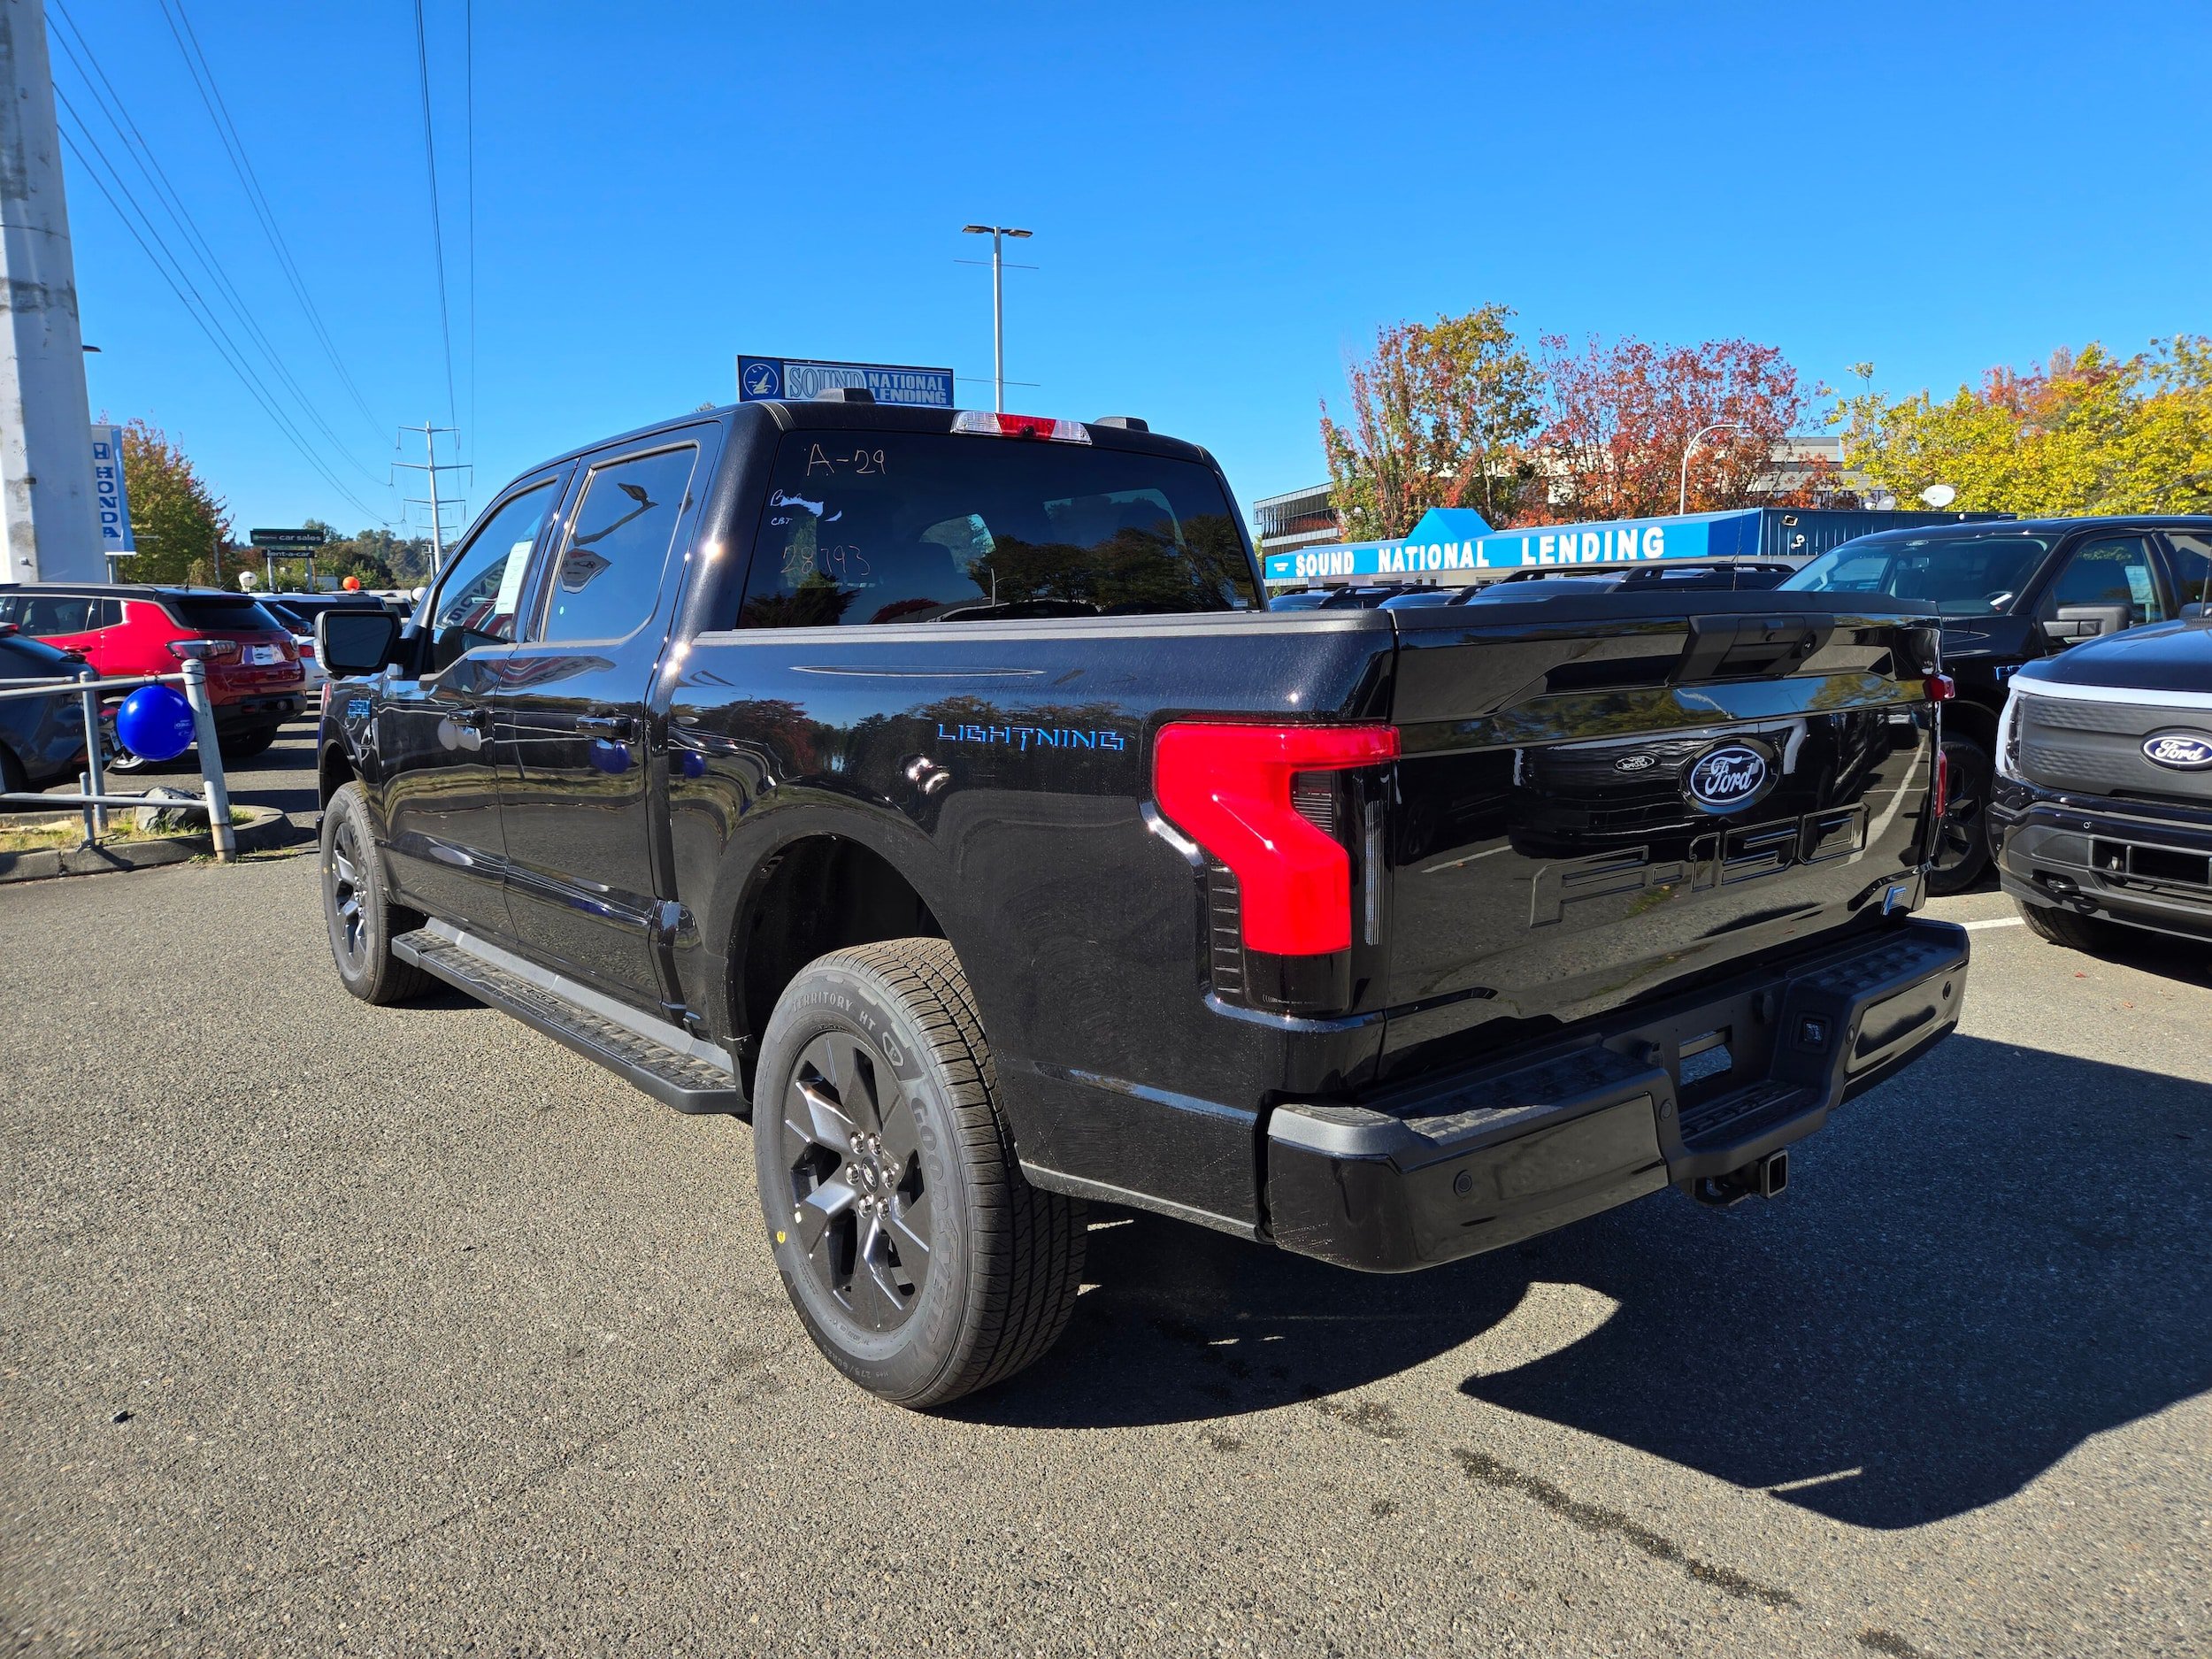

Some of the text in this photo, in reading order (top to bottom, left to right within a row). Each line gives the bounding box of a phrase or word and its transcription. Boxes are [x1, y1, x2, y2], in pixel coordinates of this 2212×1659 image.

[868, 373, 946, 391] NATIONAL
[871, 388, 947, 404] LENDING
[807, 443, 886, 476] A-29
[95, 465, 121, 538] HONDA
[1294, 526, 1664, 577] SOUND NATIONAL LENDING
[936, 723, 1125, 751] LIGHTNING
[2154, 739, 2206, 761] Ford
[1704, 755, 1753, 795] Ford
[1529, 801, 1870, 928] F-150
[792, 990, 876, 1032] TERRITORY HT
